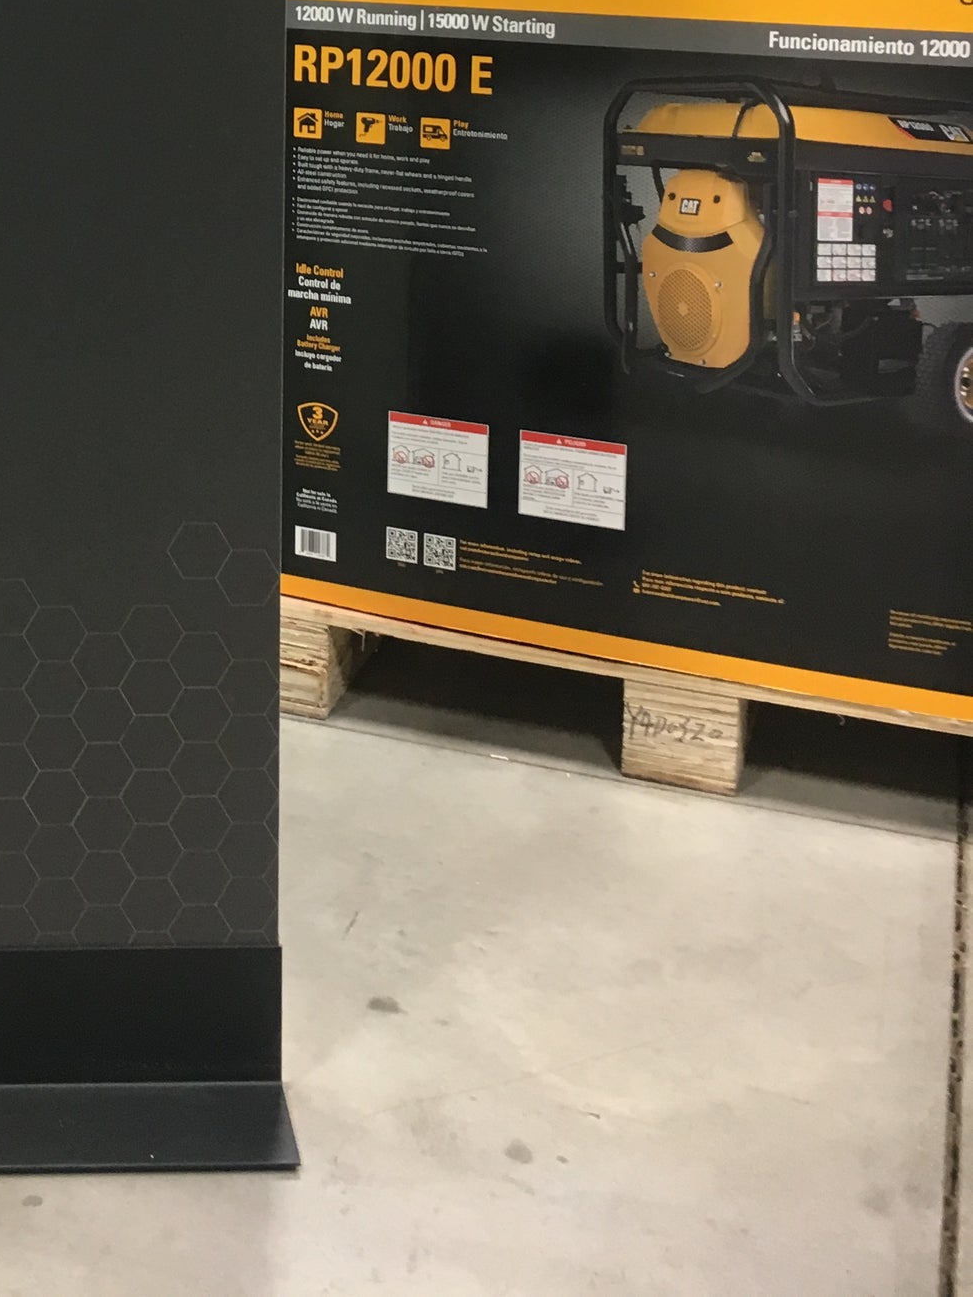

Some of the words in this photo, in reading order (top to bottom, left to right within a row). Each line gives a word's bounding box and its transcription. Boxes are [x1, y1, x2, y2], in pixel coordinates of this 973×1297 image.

[295, 5, 334, 23] 12000
[336, 8, 354, 24] W
[356, 9, 417, 30] Running
[427, 13, 469, 30] 15000
[471, 14, 490, 31] W
[492, 15, 556, 39] Starting
[769, 31, 915, 56] Funcionamiento
[920, 39, 970, 58] 12000
[293, 44, 457, 93] RP12000
[470, 55, 493, 95] E
[324, 118, 345, 129] Hogar
[388, 114, 407, 123] Work
[388, 122, 414, 133] Trabajo
[296, 262, 312, 275] Idle
[313, 264, 344, 279] Control
[298, 275, 328, 289] Control
[330, 280, 341, 290] de
[288, 288, 319, 301] marcha
[320, 290, 352, 304] mínima
[309, 306, 328, 318] AVR
[309, 318, 328, 331] AVR
[312, 406, 323, 419] 3
